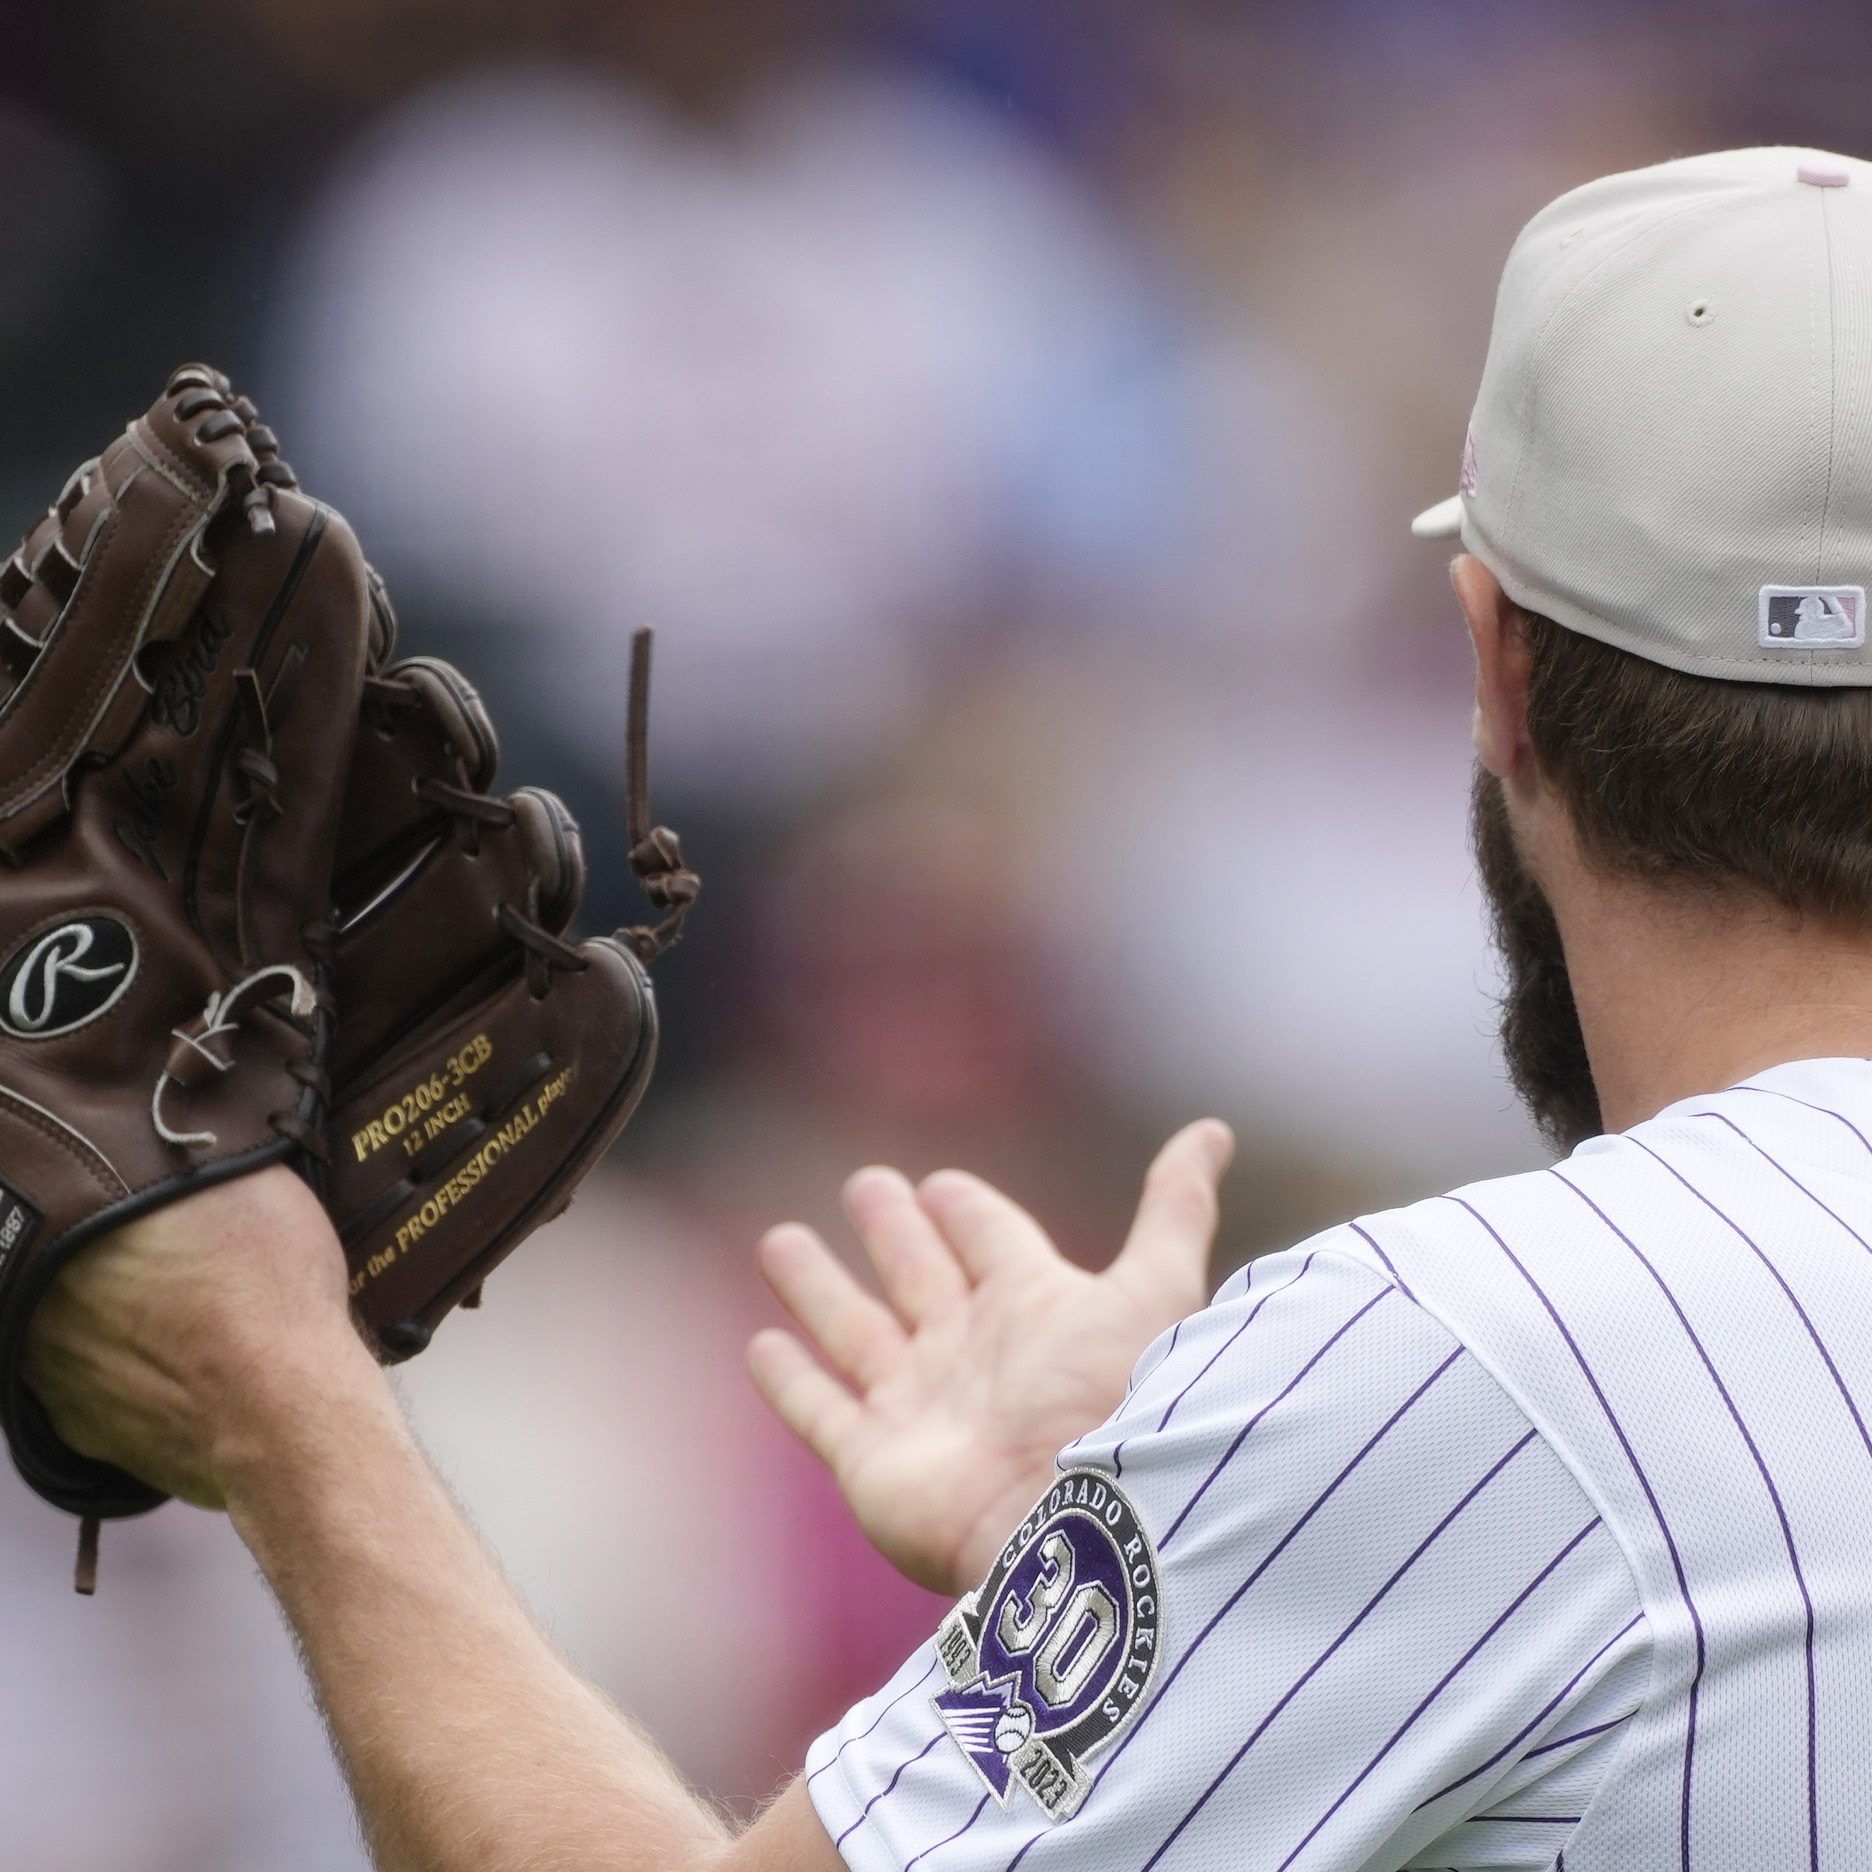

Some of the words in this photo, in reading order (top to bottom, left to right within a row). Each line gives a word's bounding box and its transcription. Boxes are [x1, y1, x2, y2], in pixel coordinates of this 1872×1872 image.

[150, 606, 233, 738] Bird
[8, 923, 126, 1031] R
[351, 1033, 494, 1163] PRO206-3CB
[402, 1130, 425, 1157] 12
[424, 1092, 473, 1141] INCH
[367, 1246, 396, 1278] the
[395, 1104, 539, 1254] PROFESSIONAL
[939, 1624, 971, 1677] 1993
[996, 1529, 1120, 1711] 30
[1001, 1477, 1124, 1570] COLORADO
[1101, 1532, 1156, 1723] ROCKIES
[1019, 1749, 1067, 1810] 2023
